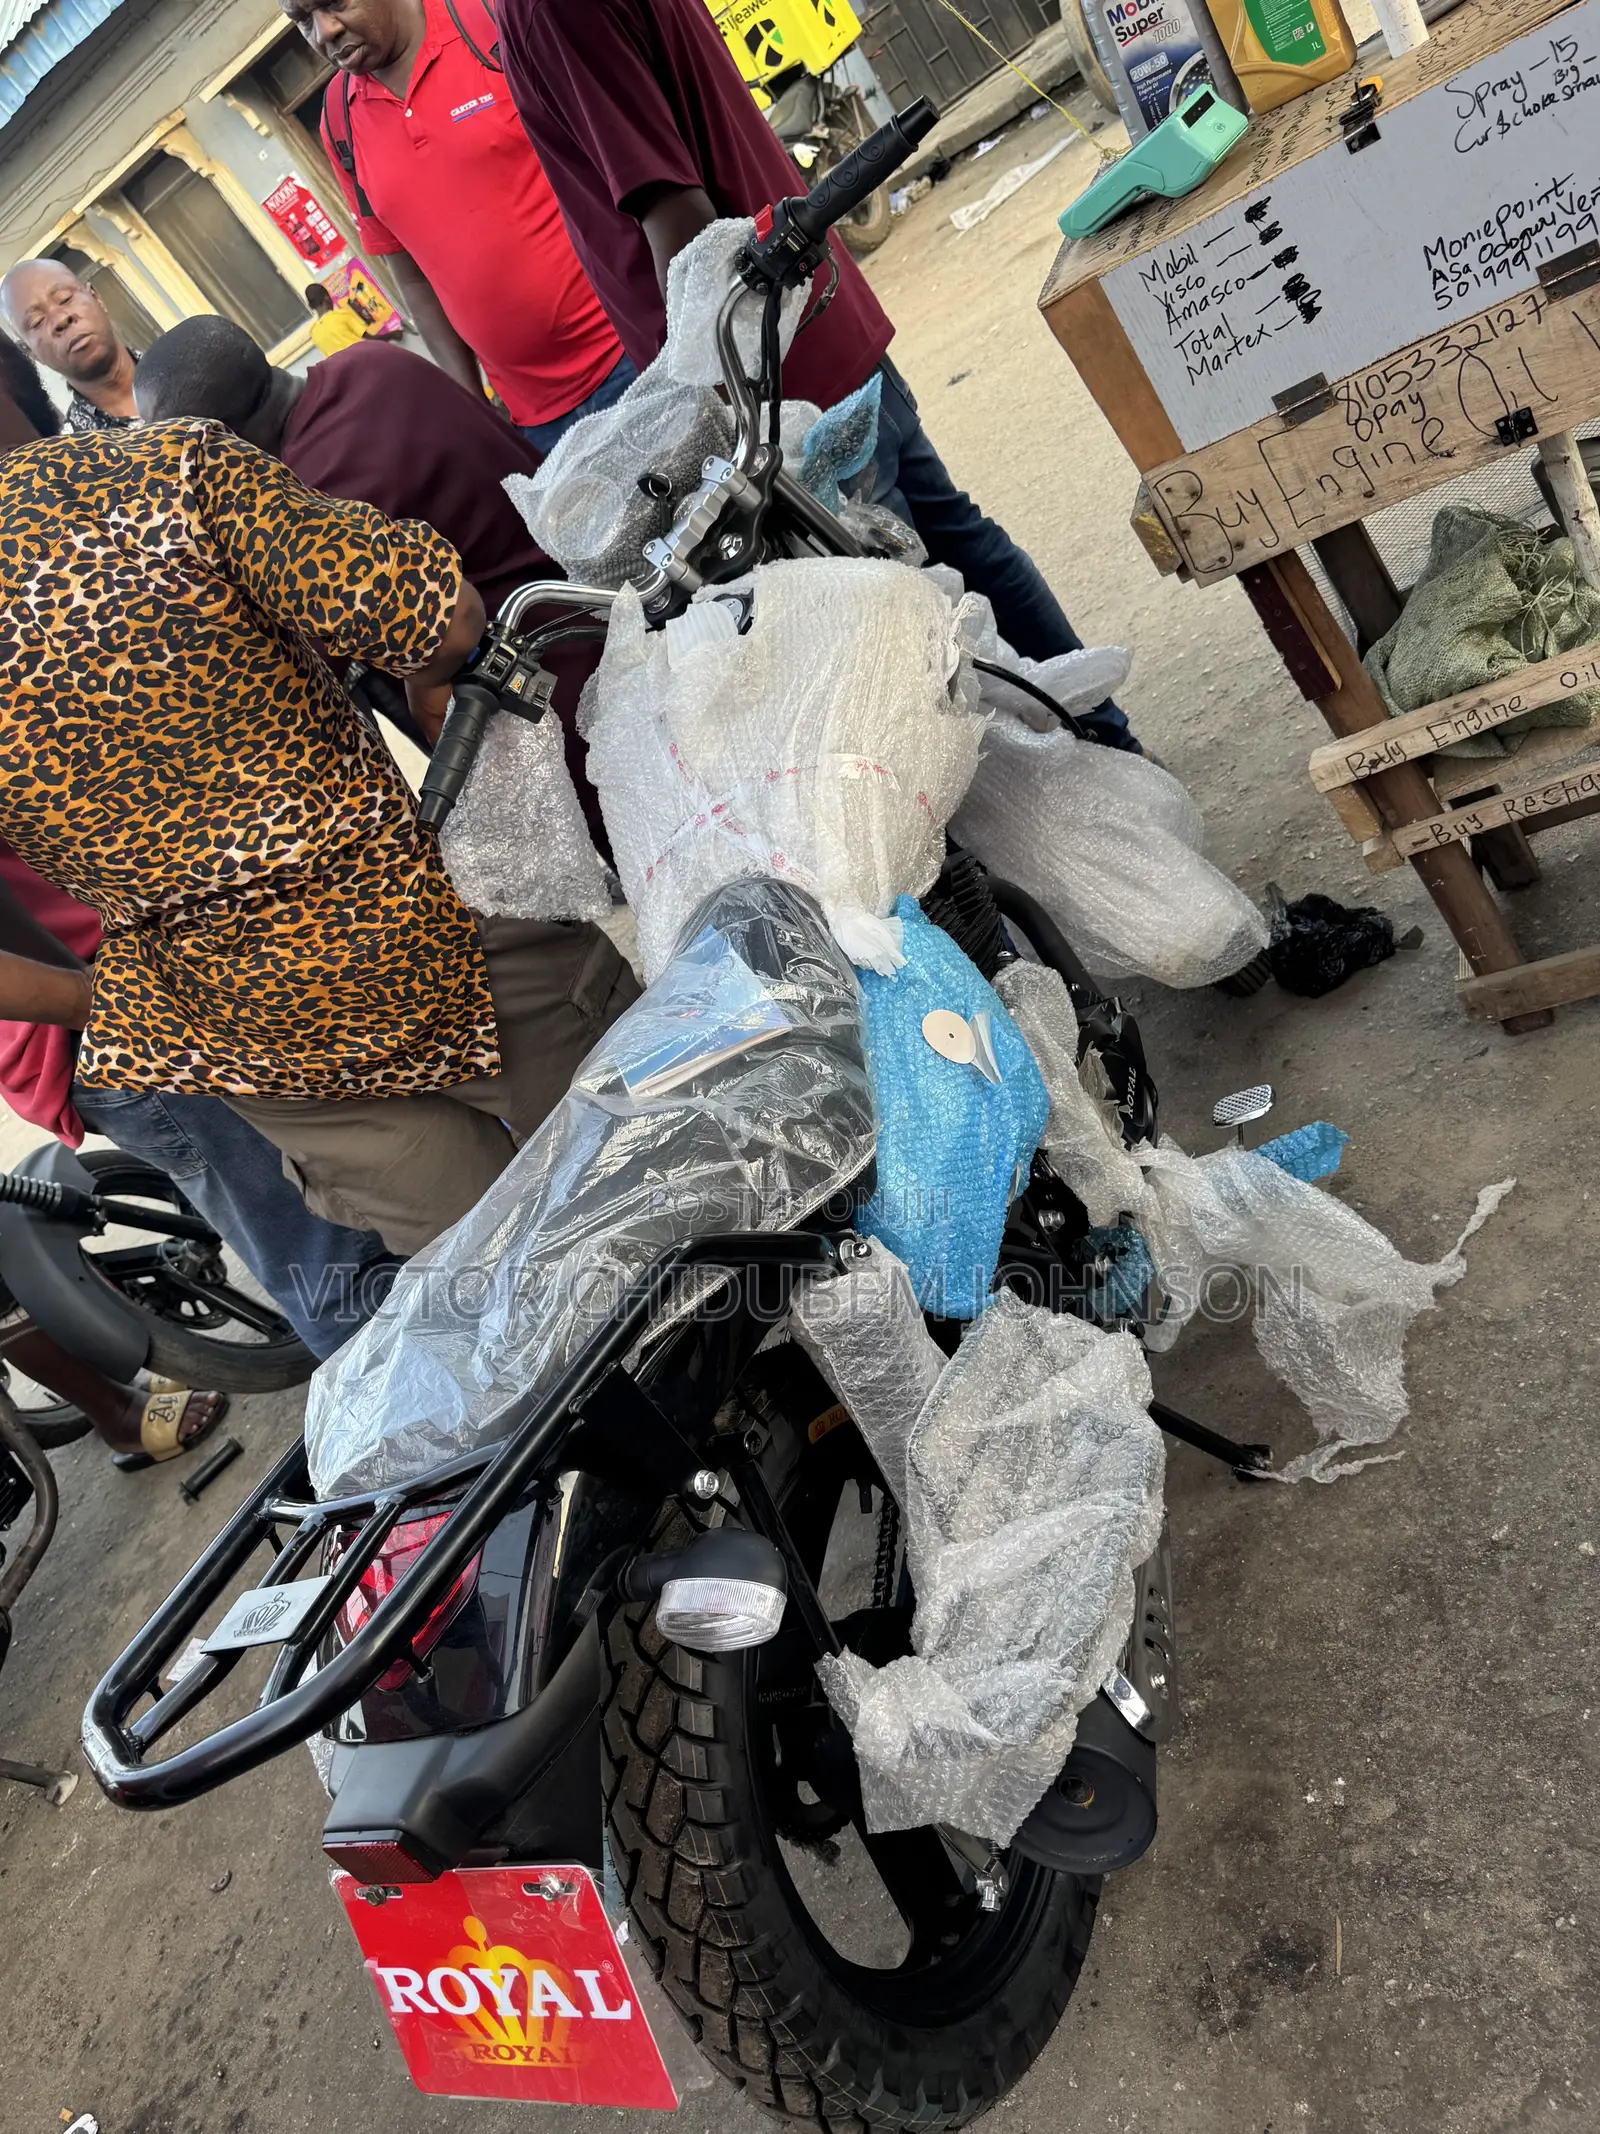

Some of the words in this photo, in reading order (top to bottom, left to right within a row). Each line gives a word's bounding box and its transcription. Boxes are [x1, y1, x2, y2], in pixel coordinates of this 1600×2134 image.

[726, 0, 773, 31] Ijeawe
[1115, 7, 1164, 43] Super
[1153, 18, 1181, 44] 1000
[1131, 54, 1168, 81] 20W-50
[1311, 41, 1321, 52] 1L
[1444, 71, 1527, 119] Spray
[1139, 242, 1199, 292] Mobil
[1153, 275, 1206, 308] Visco
[1165, 278, 1246, 336] Amasco
[1173, 312, 1239, 362] Total
[1187, 323, 1272, 386] Martex
[1335, 294, 1548, 426] 8105332127
[1153, 469, 1281, 575] Buy
[1257, 416, 1456, 530] Engine
[1426, 694, 1528, 749] Engine
[1429, 812, 1484, 846] Buy
[1127, 1066, 1138, 1120] ROYAL
[376, 1966, 632, 2020] ROYAL
[470, 2041, 584, 2065] ROYAL
